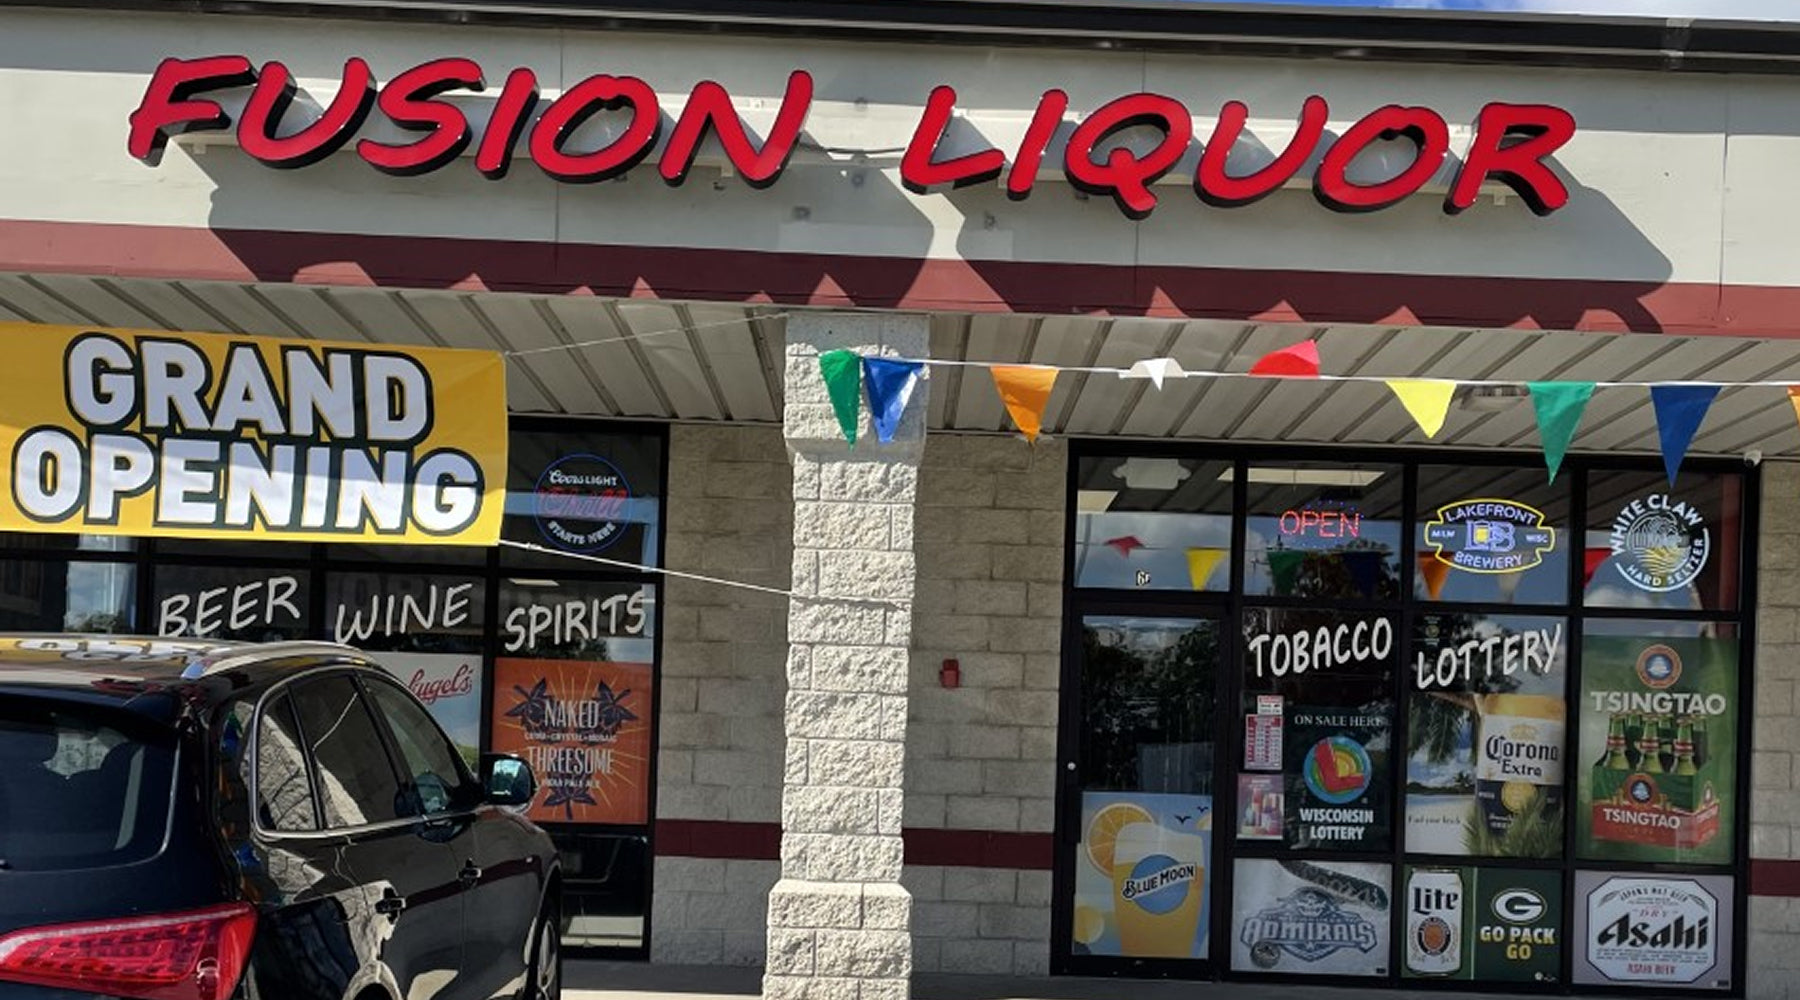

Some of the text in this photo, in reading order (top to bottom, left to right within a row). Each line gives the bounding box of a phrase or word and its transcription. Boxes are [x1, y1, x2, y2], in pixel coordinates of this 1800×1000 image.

[128, 55, 1576, 217] FUSION LIQUOR
[66, 334, 431, 444] GRAND
[12, 426, 484, 535] OPENING
[585, 475, 618, 486] LIGHT
[1279, 510, 1361, 538] OPEN
[1445, 503, 1537, 525] LAKEFRONT
[1610, 494, 1703, 556] WHITE CLAW
[548, 520, 585, 544] STARTS
[1454, 550, 1523, 569] BREWERY
[1626, 538, 1704, 586] HARD SELTZER
[158, 576, 300, 637] BEER
[335, 583, 472, 644] WINE
[505, 590, 646, 651] SPIRITS
[1249, 617, 1393, 677] TOBACCO
[1416, 623, 1562, 690] LOTTERY
[544, 700, 600, 729] NAKED
[1591, 691, 1726, 715] TSINGTAO
[1294, 714, 1315, 725] ON
[1316, 714, 1347, 727] SALE
[527, 745, 615, 775] THREESOME
[1486, 735, 1559, 765] Corona
[1501, 758, 1542, 777] Extra
[1300, 808, 1374, 824] WISCONSIN
[1603, 807, 1681, 829] TSINGTAO
[1310, 826, 1366, 841] LOTTERY
[1122, 864, 1195, 899] BLUE MOON
[1413, 887, 1458, 915] Lite
[1245, 917, 1376, 952] ADMIRALS
[1480, 926, 1555, 945] GO PACK
[1597, 913, 1709, 949] Asahi
[1506, 944, 1531, 960] GO
